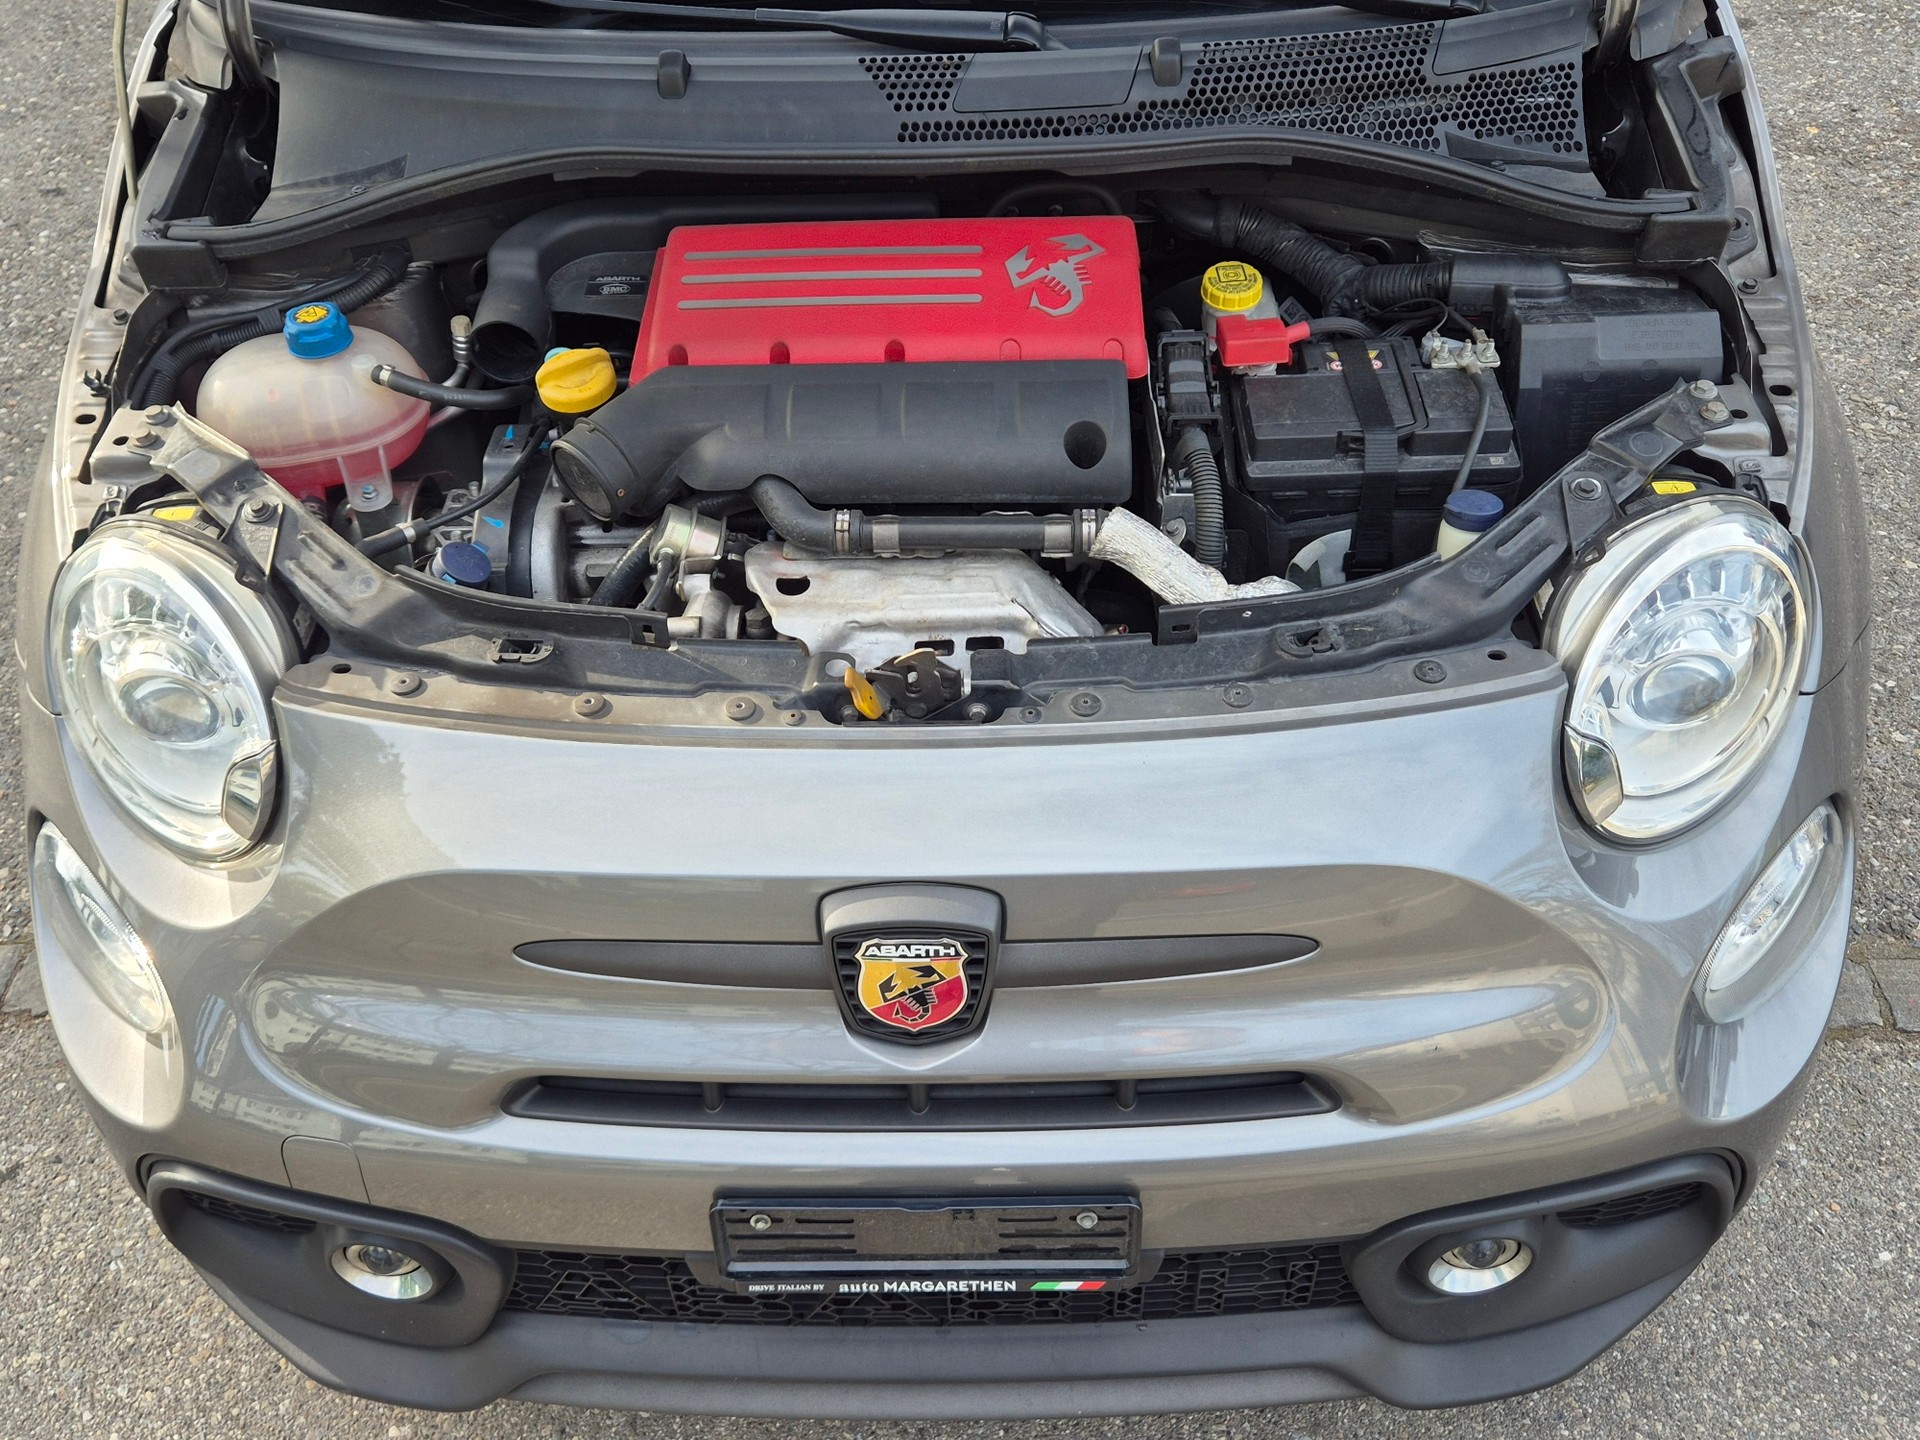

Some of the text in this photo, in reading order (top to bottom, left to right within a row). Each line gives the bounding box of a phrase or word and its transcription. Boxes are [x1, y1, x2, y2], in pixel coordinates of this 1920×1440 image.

[864, 945, 955, 957] ABARTH
[748, 1284, 775, 1292] DRIVE
[777, 1284, 811, 1292] ITALIAN
[838, 1281, 879, 1293] auto
[883, 1280, 1017, 1292] MARGARETHEN
